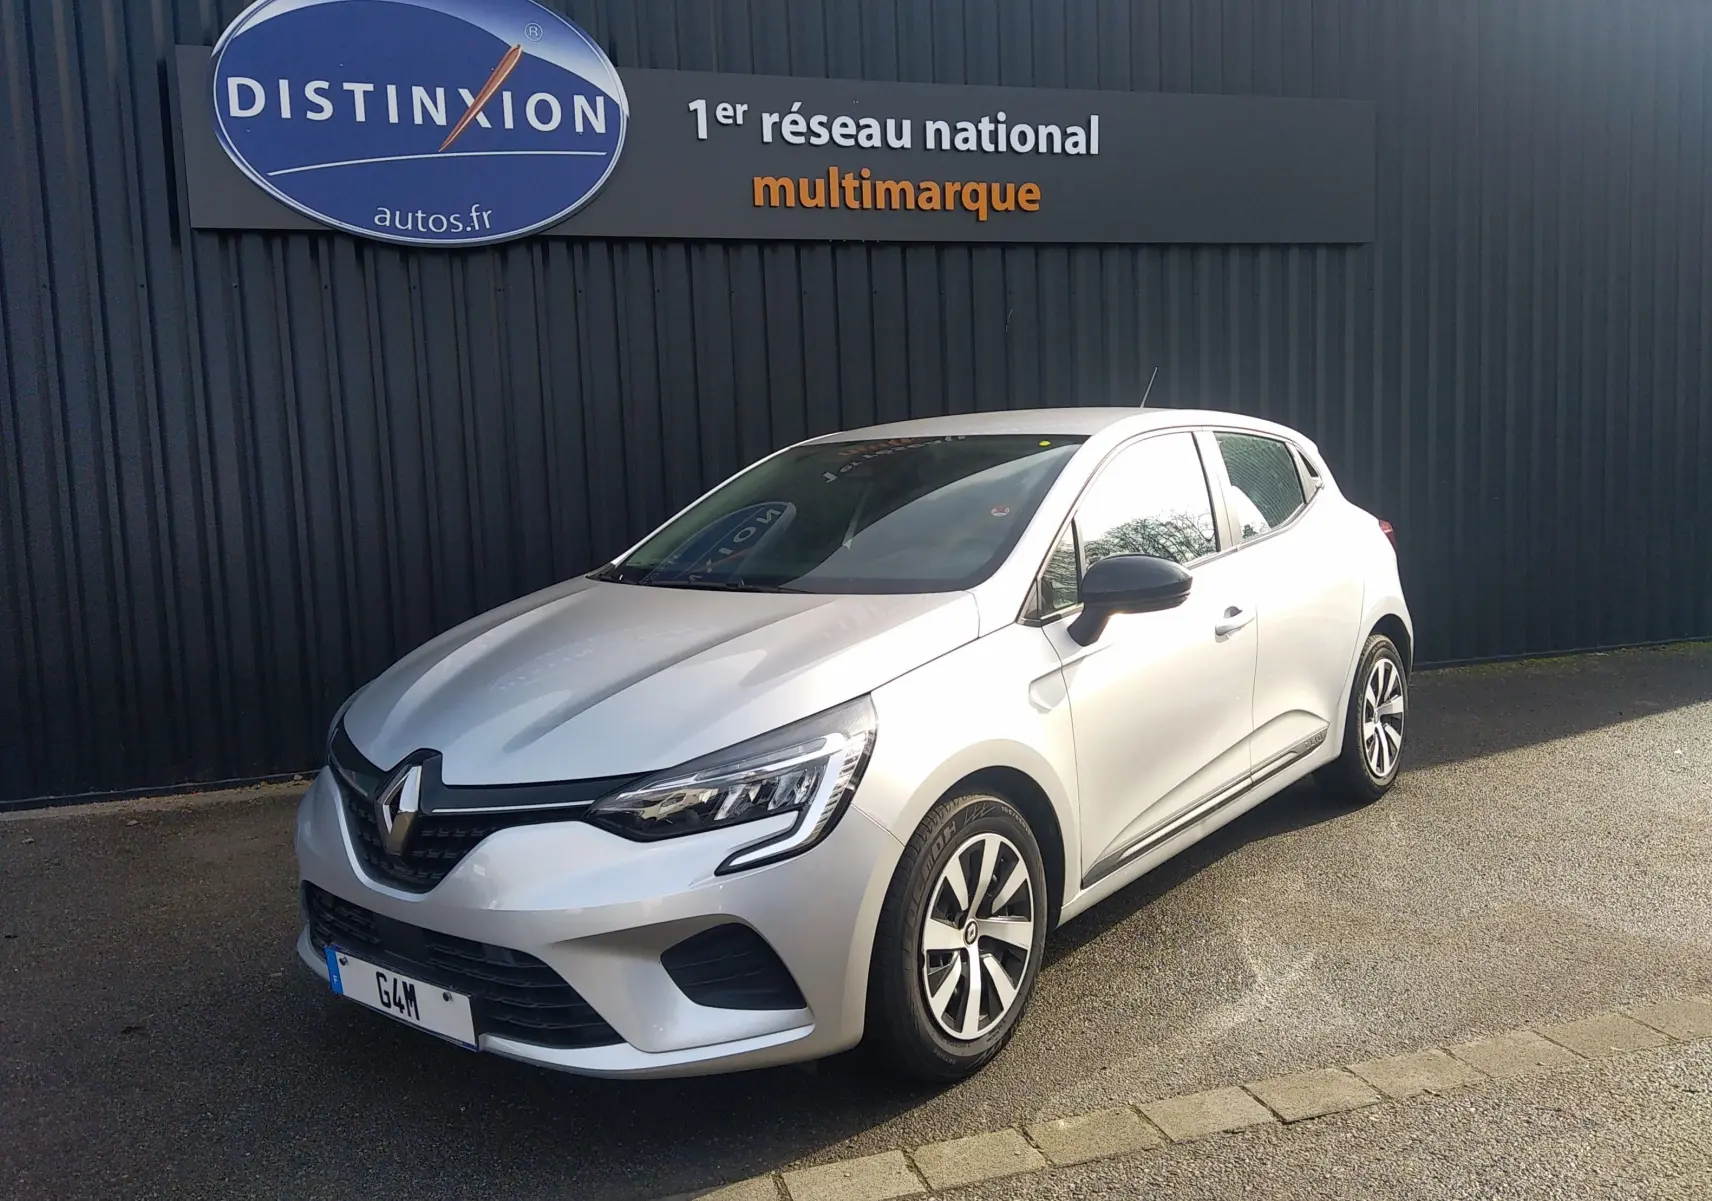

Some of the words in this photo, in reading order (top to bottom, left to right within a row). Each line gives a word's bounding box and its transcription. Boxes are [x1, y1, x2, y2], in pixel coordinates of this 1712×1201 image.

[226, 76, 607, 134] DISTINXION
[688, 98, 749, 140] 1er
[762, 101, 912, 149] réseau
[925, 111, 1100, 155] national
[373, 203, 493, 233] autos.fr
[753, 166, 1042, 221] multimarque
[375, 970, 421, 1022] G4M
